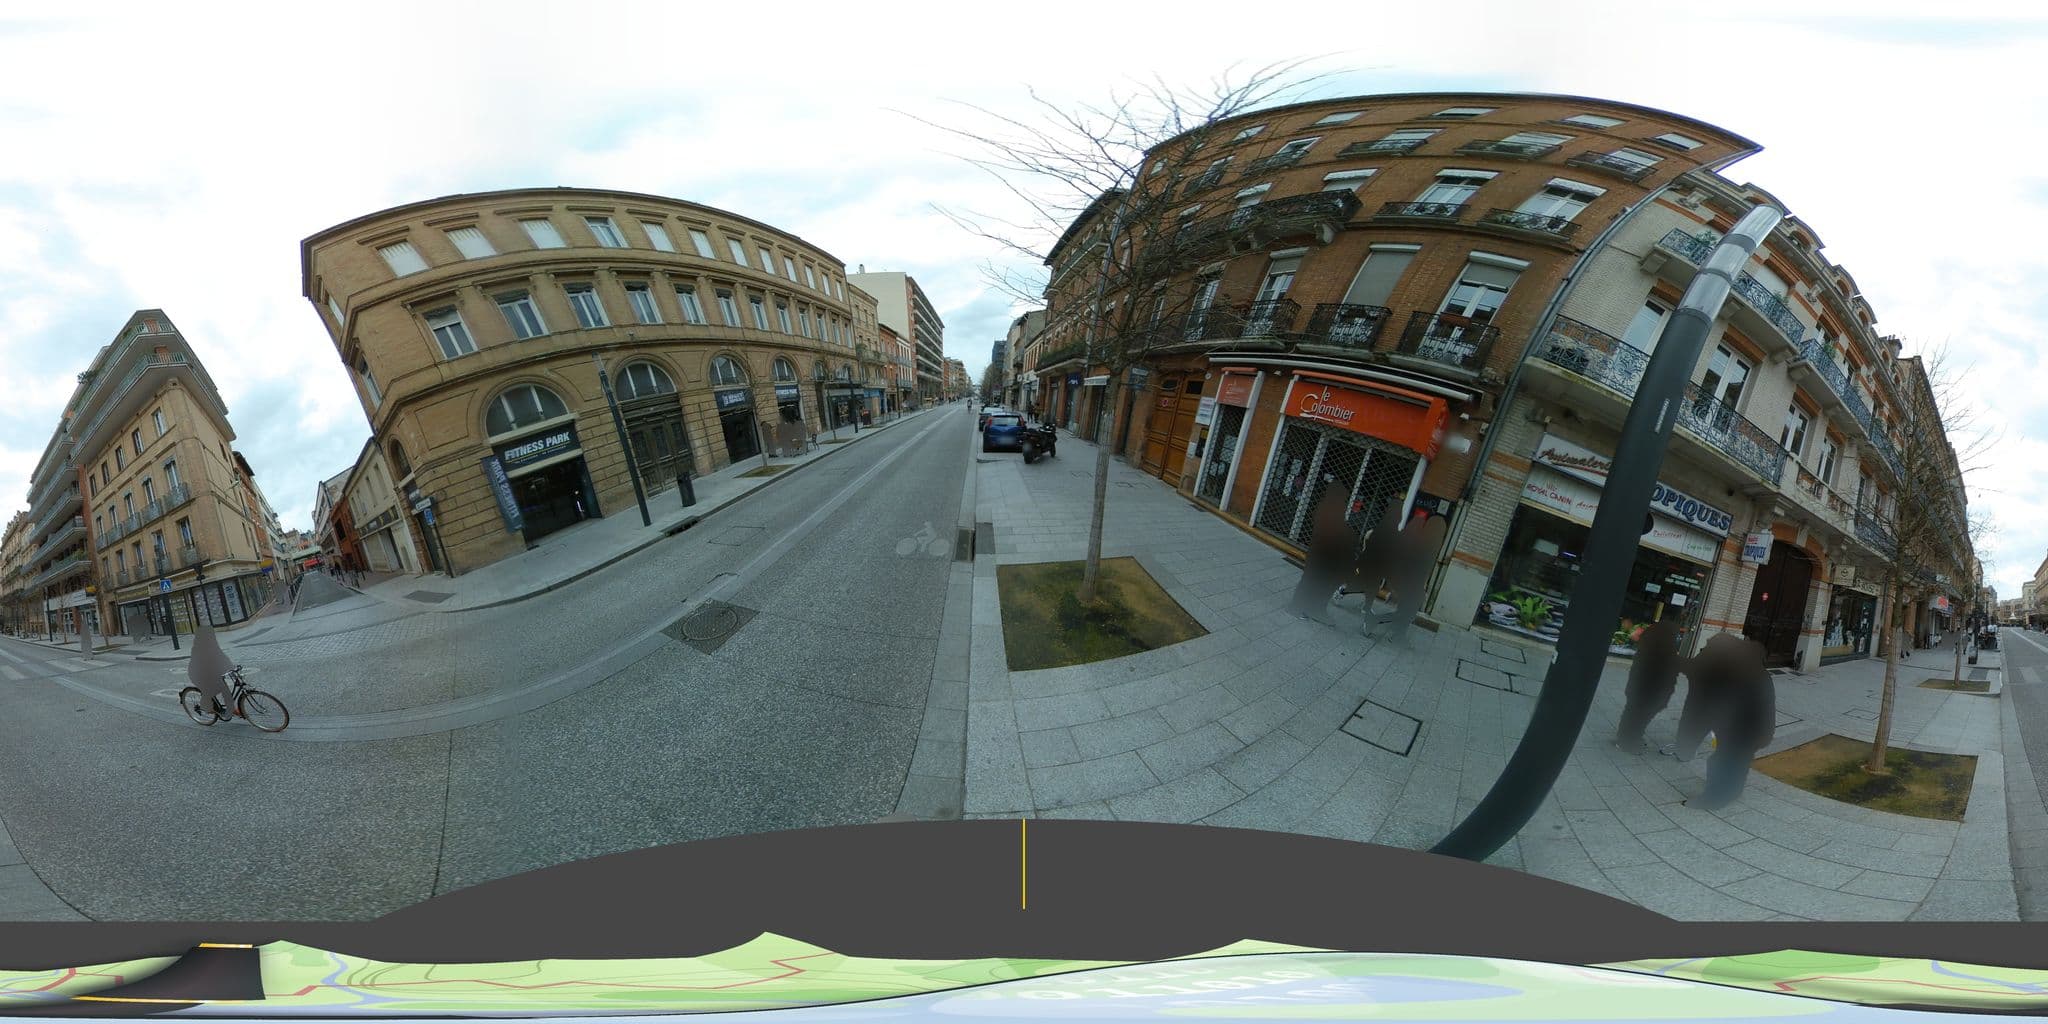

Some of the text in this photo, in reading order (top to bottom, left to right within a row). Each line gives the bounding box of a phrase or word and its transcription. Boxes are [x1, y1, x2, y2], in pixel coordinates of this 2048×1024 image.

[1300, 393, 1355, 420] Colombier
[504, 439, 544, 460] FITNESS
[546, 431, 570, 447] PARK
